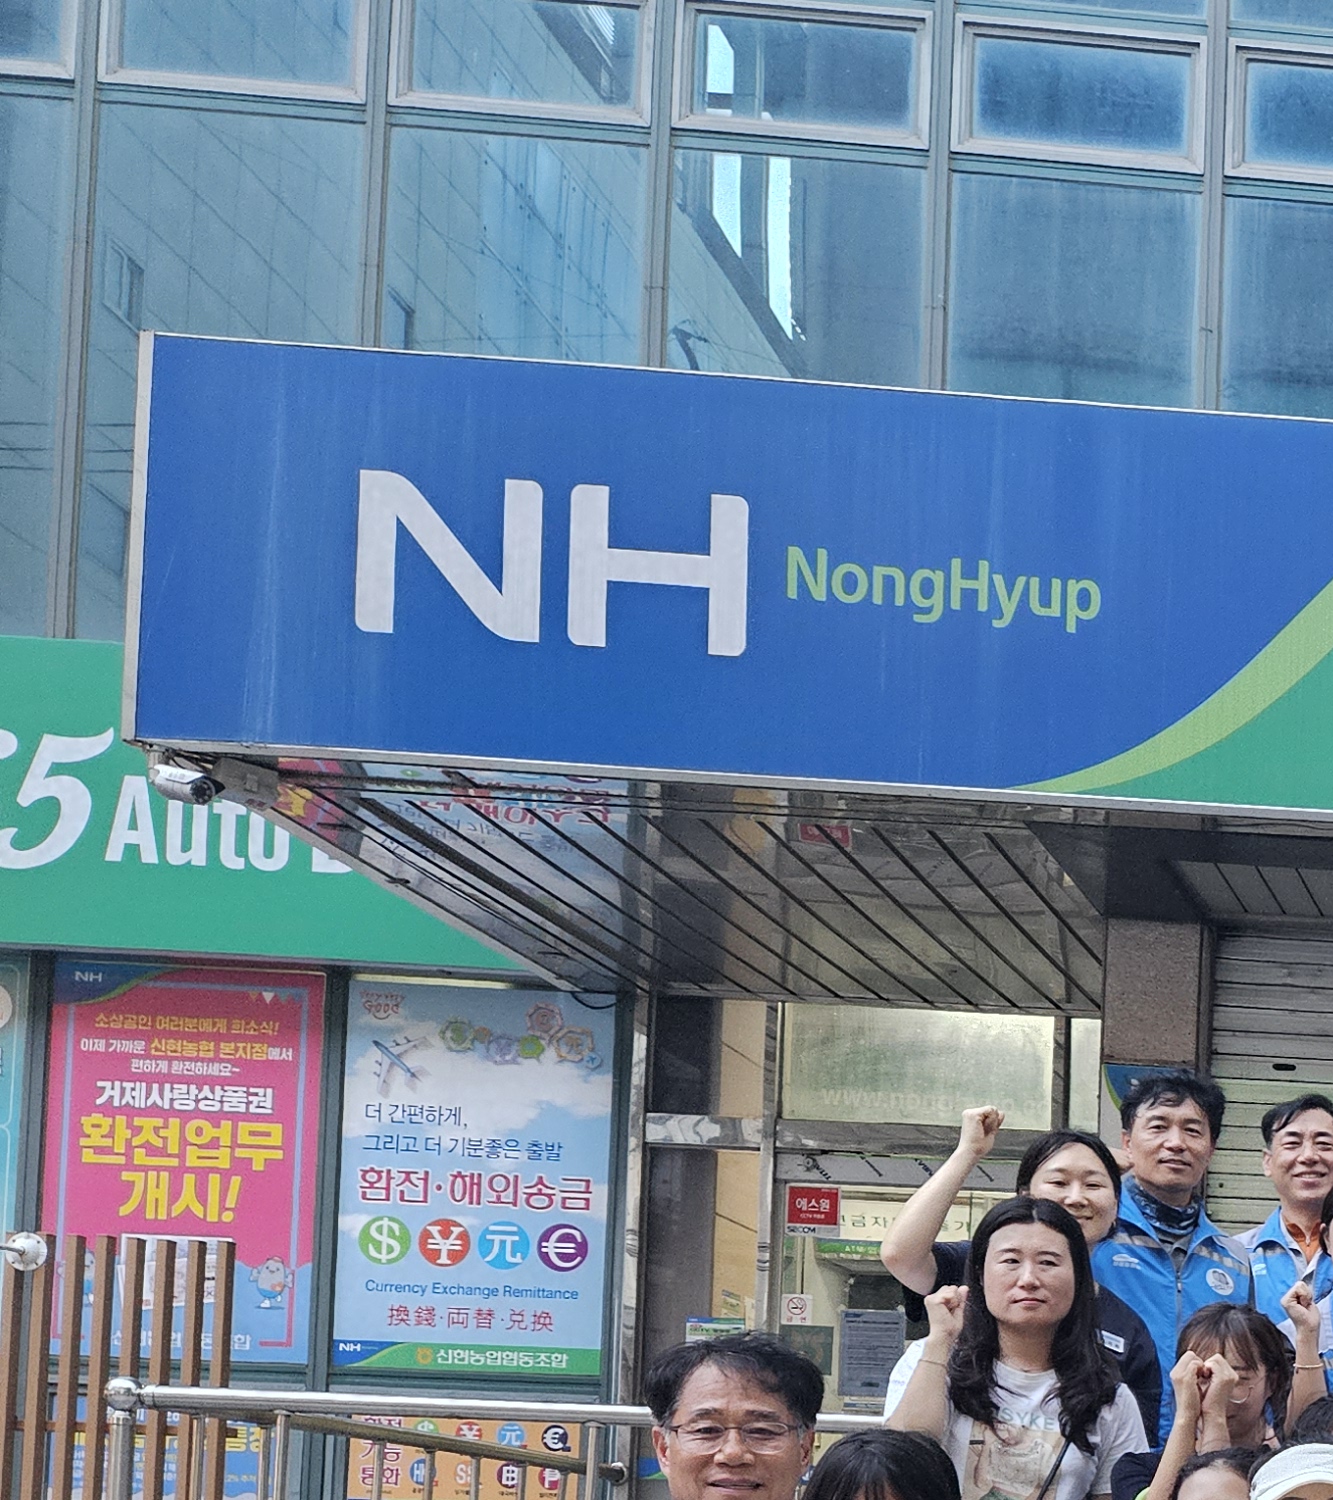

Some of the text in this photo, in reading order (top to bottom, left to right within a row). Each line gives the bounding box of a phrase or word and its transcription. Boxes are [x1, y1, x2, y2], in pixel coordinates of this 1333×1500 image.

[355, 469, 1102, 657] NH NongHyup
[104, 774, 291, 872] Auto
[74, 970, 103, 983] NH
[80, 1037, 106, 1053] 이제
[108, 1038, 146, 1055] 가까운
[150, 1037, 214, 1059] 신현농협
[130, 1058, 169, 1075] 편하게
[94, 1079, 275, 1115] 거제사랑상품권
[364, 1102, 468, 1129] 더 간편하게,
[78, 1112, 285, 1172] 환전업무
[362, 1133, 564, 1162] 그리고 더 기분좋은 출발
[118, 1170, 243, 1223] 개시!
[795, 1197, 830, 1213] 에스원
[365, 1278, 579, 1301] Currency Exchange Remittance
[338, 1341, 362, 1353] NH
[435, 1347, 569, 1369] 신현농업협동조합
